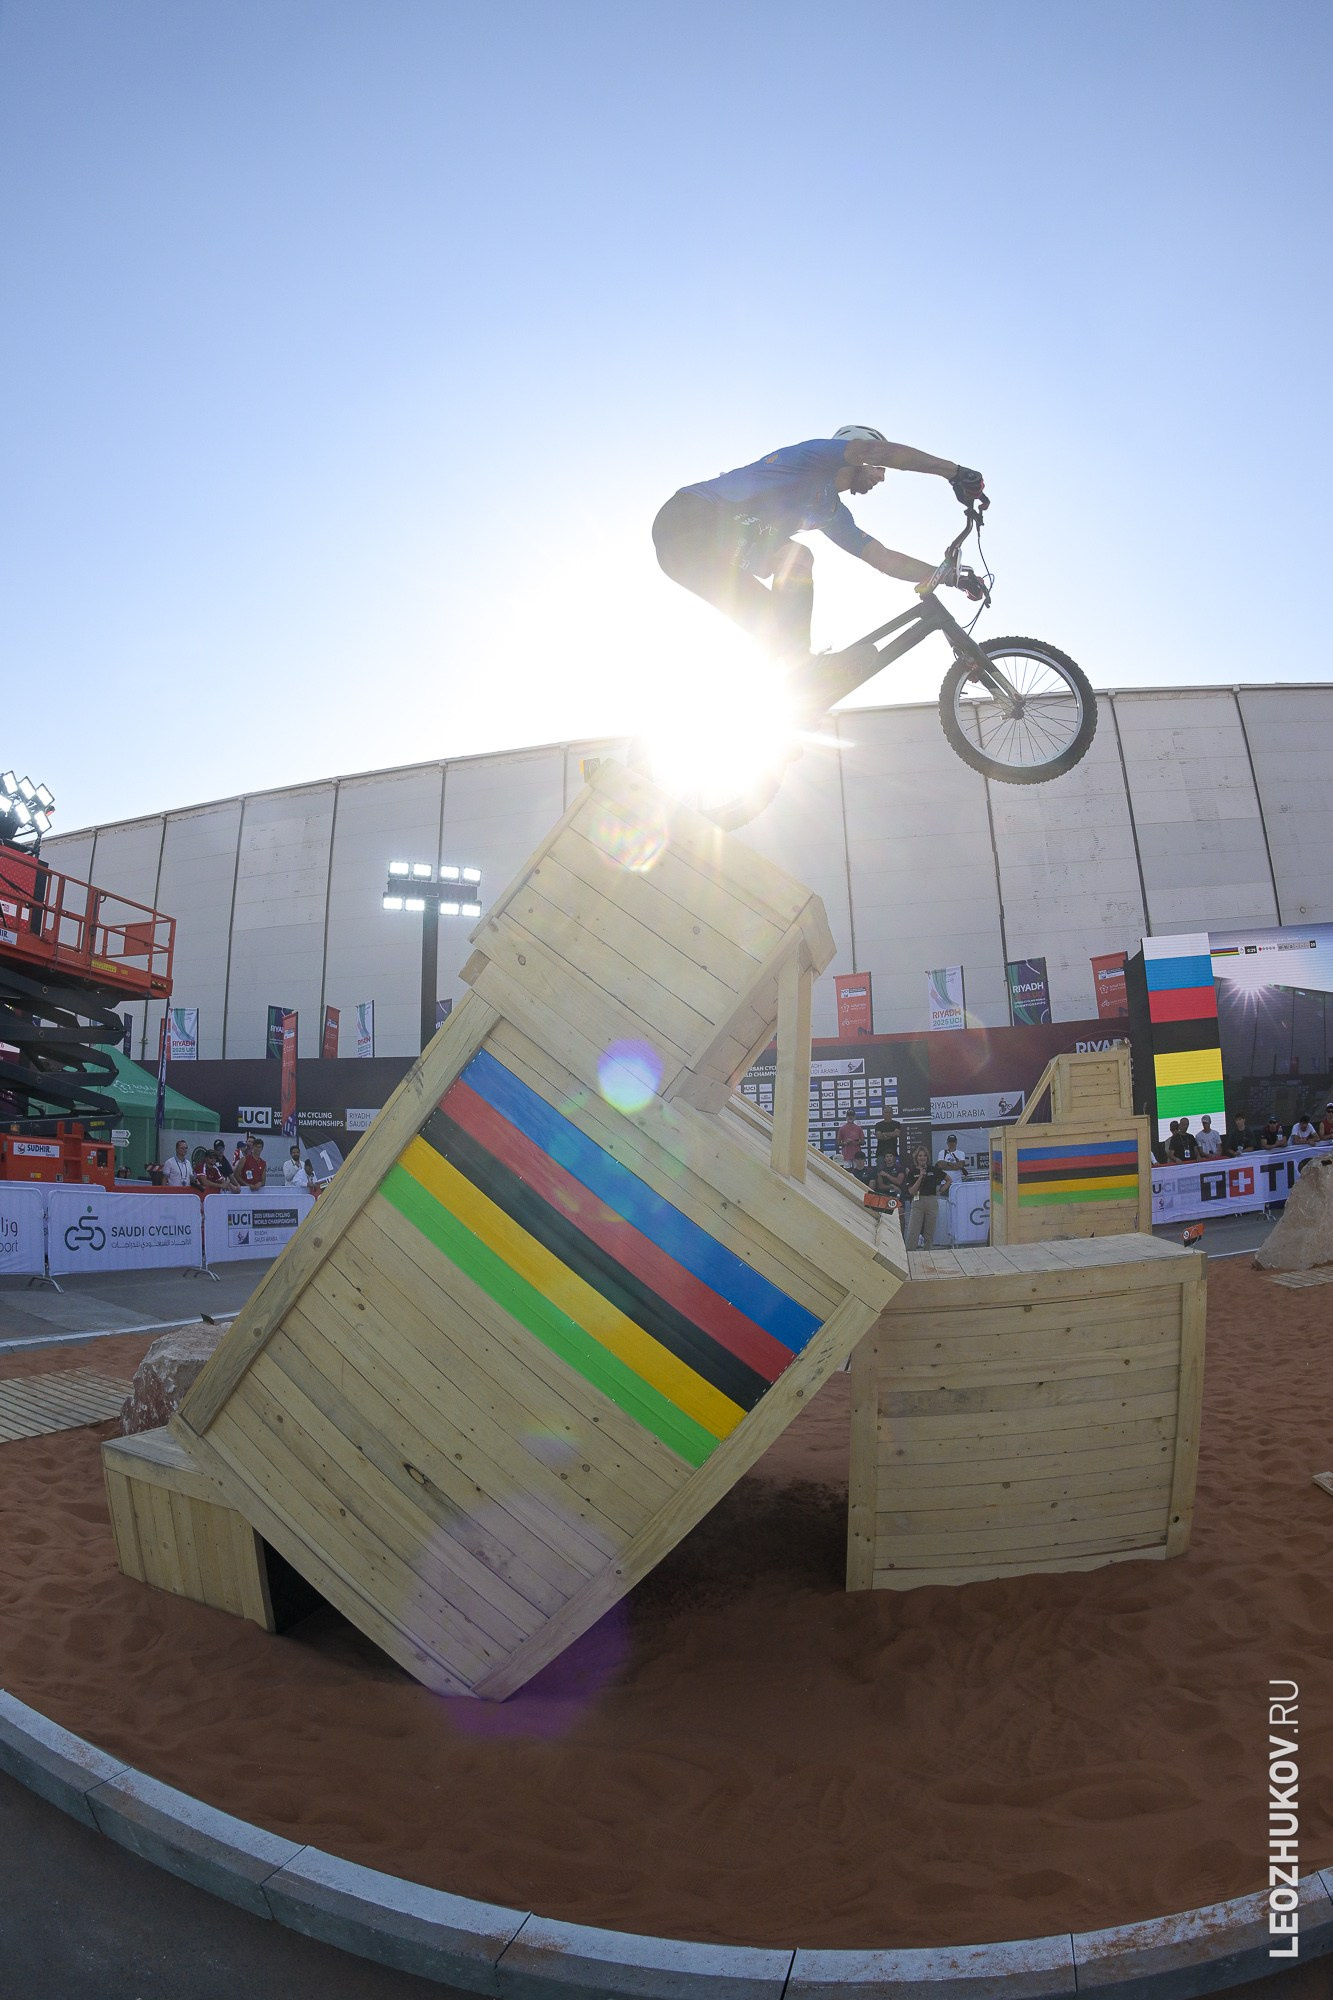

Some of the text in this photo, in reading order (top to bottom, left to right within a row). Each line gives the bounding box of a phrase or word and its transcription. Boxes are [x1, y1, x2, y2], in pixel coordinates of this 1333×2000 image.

[1013, 982, 1044, 993] RIYADH
[933, 1009, 961, 1019] RIYADH
[930, 1101, 959, 1110] RIYADH
[243, 1111, 269, 1125] UCI
[930, 1109, 985, 1120] SAUDI ARABIA
[298, 1119, 344, 1127] HAMPIONSHIPS
[319, 1149, 334, 1171] 1
[1260, 1158, 1313, 1192] TI
[232, 1213, 251, 1225] UCI
[111, 1225, 192, 1237] SAUDI CYCLING
